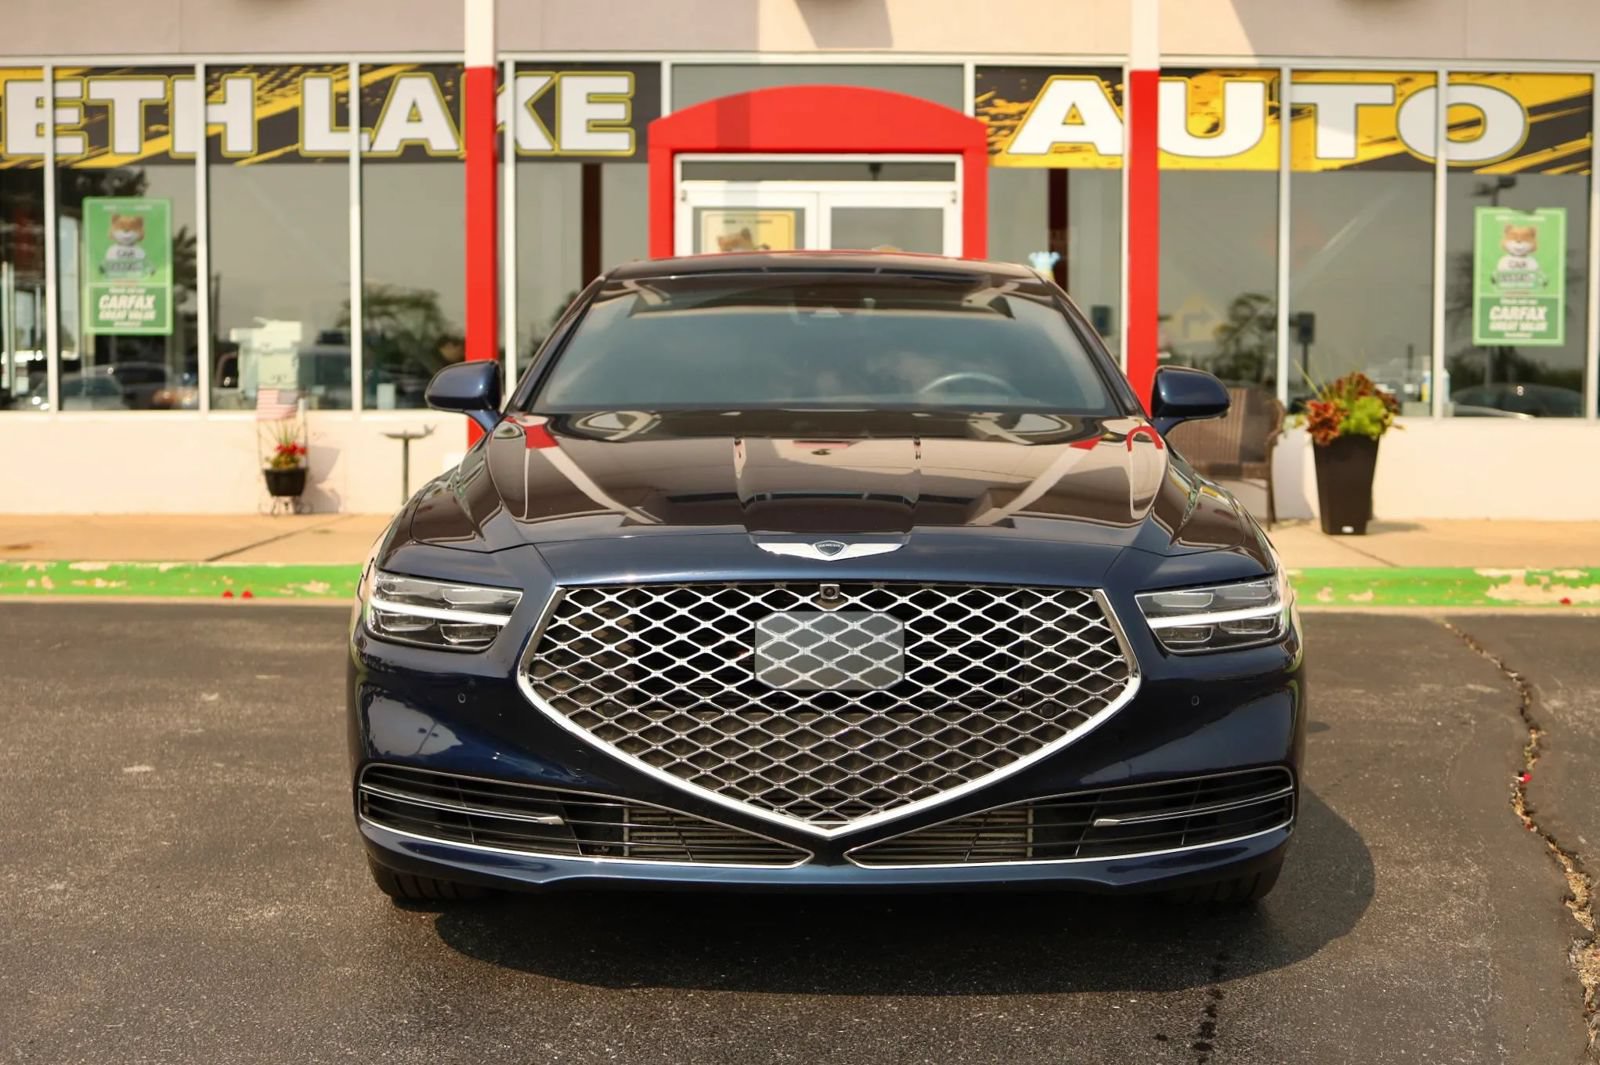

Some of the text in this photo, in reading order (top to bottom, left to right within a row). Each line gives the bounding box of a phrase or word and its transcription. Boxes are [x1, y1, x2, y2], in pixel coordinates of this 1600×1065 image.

[3, 73, 1529, 167] ETH LAKE AUTO
[98, 294, 156, 310] CARFAX
[1489, 305, 1548, 320] CARFAX
